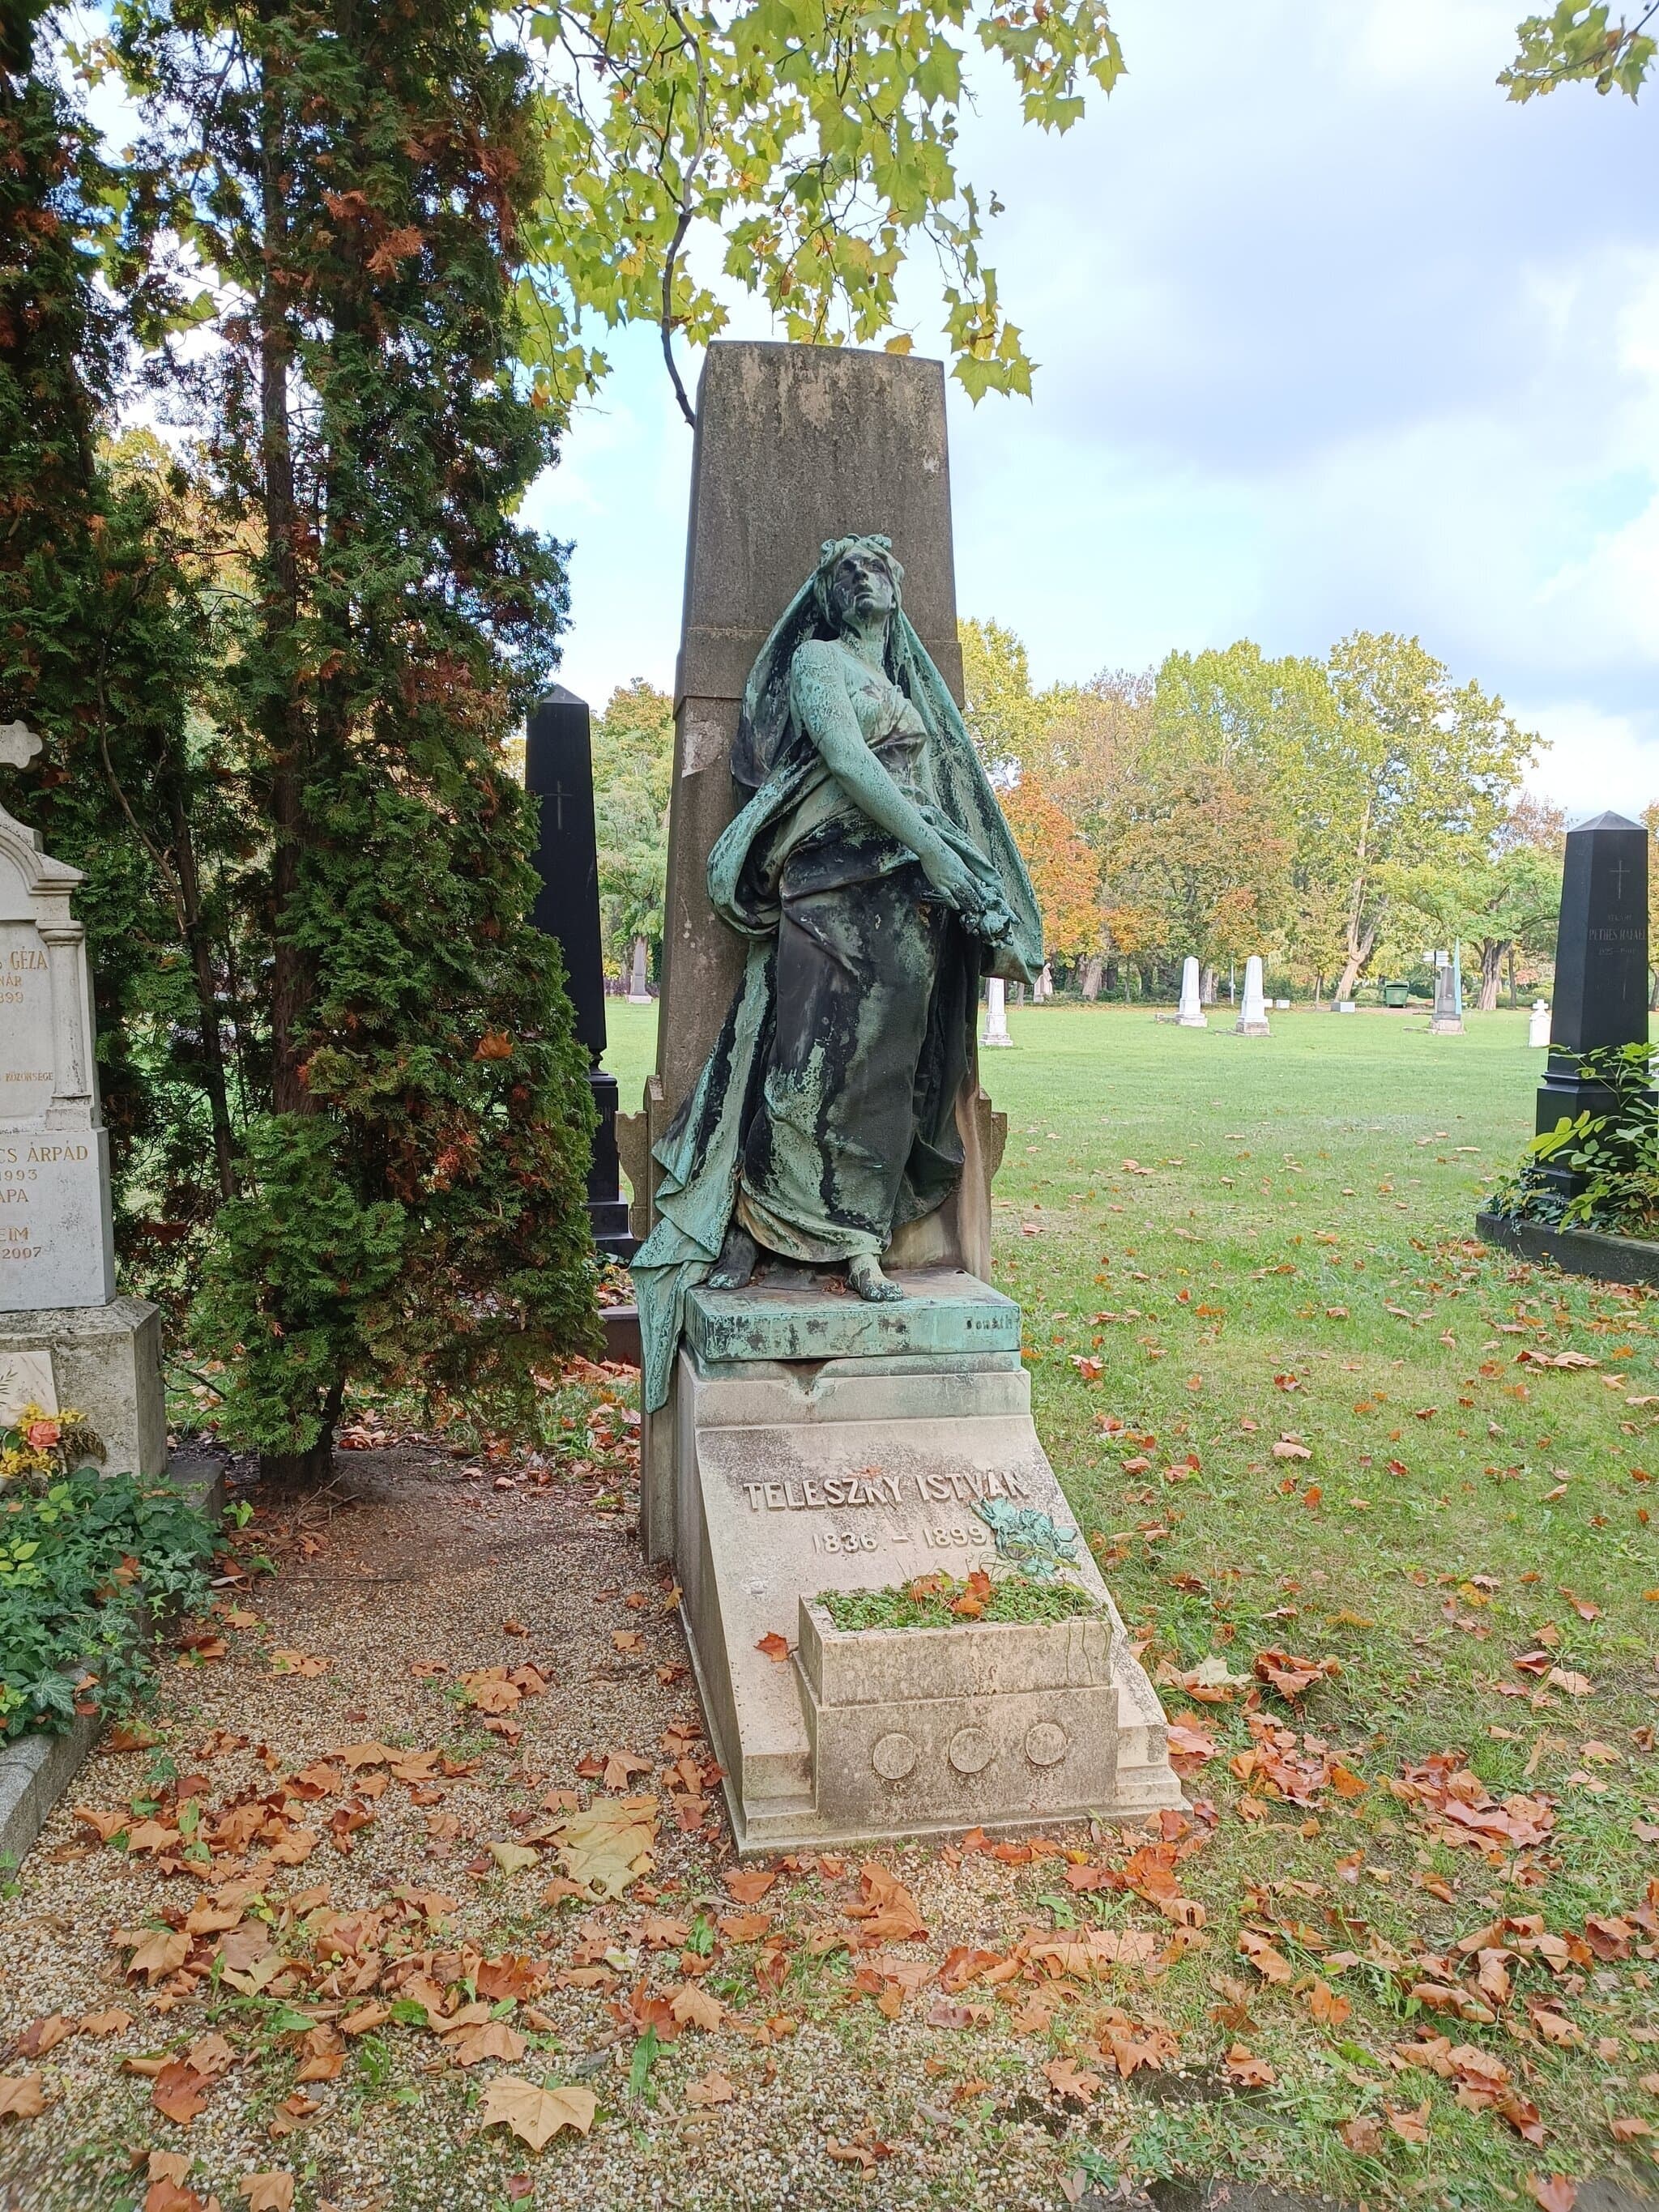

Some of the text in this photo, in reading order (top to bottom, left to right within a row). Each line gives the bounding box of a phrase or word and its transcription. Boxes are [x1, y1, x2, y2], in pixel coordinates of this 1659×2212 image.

[10, 945, 49, 970] GÉZA
[27, 1140, 89, 1162] ÁRPÁD
[2, 1247, 42, 1259] 2007
[813, 1532, 878, 1554] 1836
[923, 1525, 987, 1549] 1899
